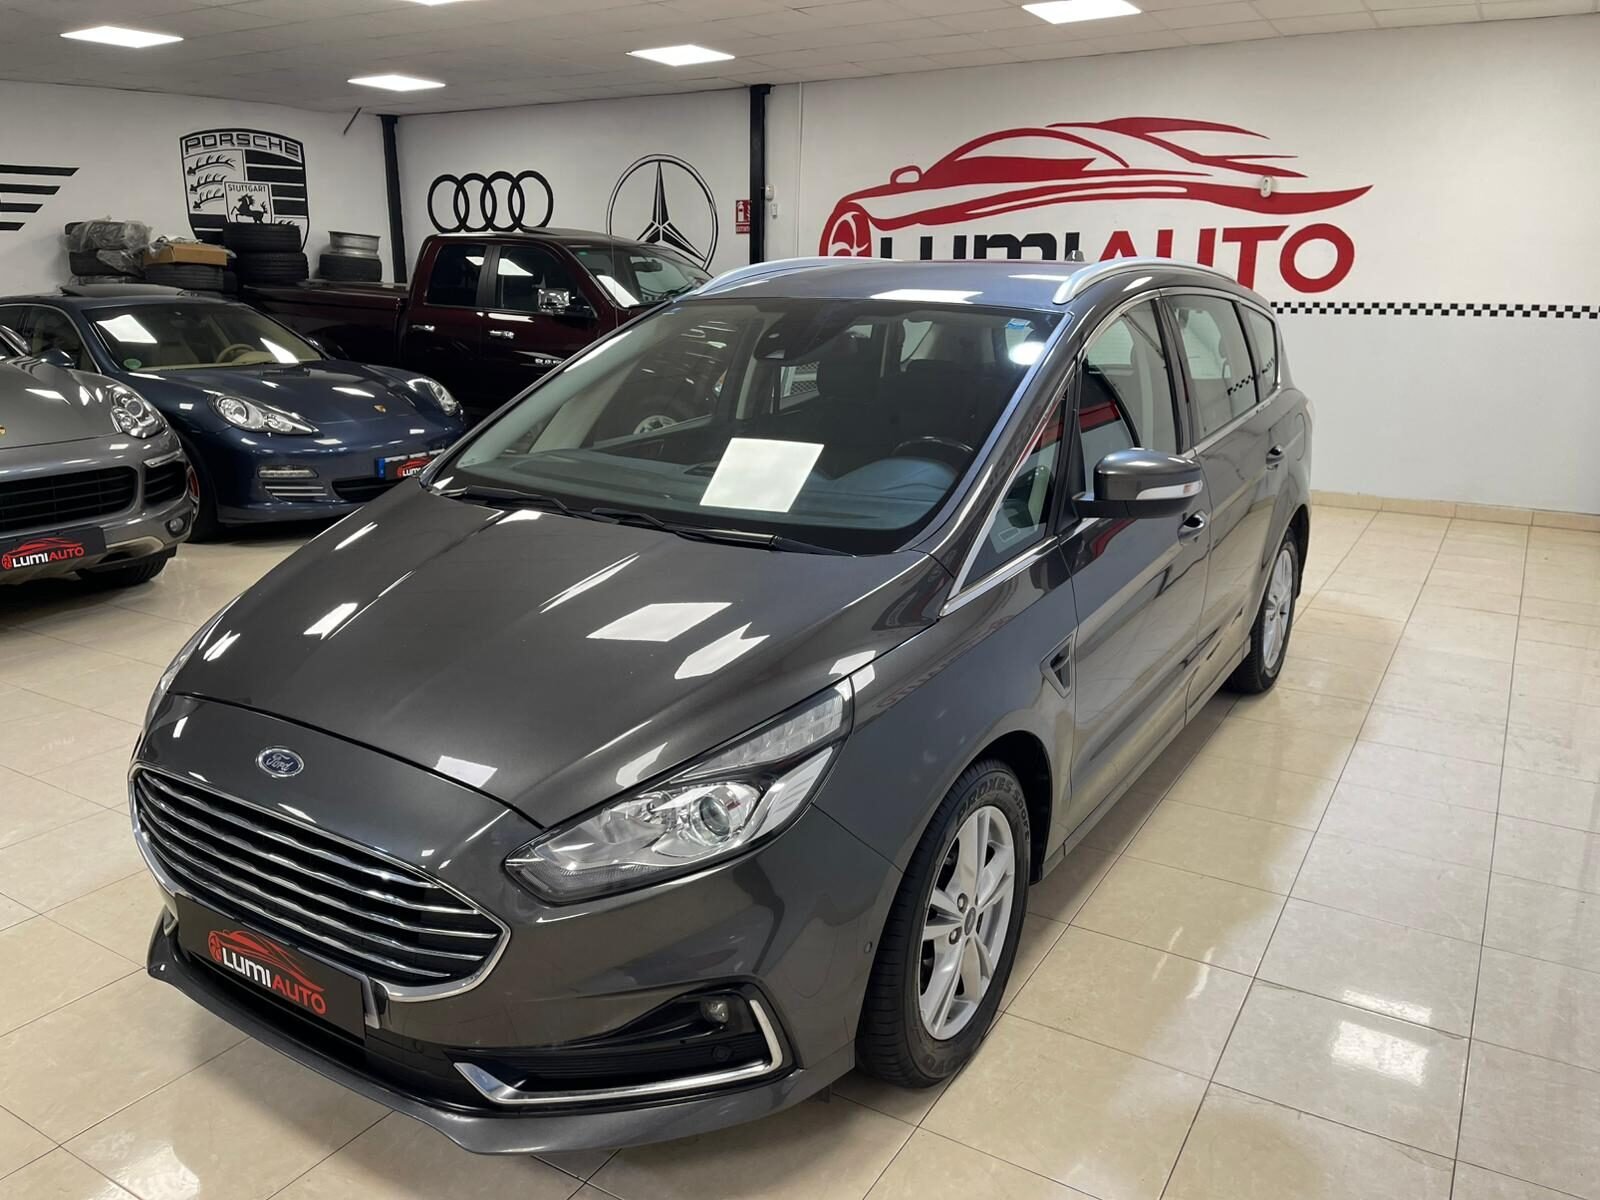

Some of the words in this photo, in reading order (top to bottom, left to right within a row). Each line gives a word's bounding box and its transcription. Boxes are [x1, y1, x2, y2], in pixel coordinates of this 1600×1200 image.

[184, 133, 299, 157] PORSCHE
[228, 184, 267, 193] STUTTGART
[12, 546, 85, 568] LUMIAUTO
[265, 752, 294, 772] Ford
[222, 946, 327, 1015] LUMIAUTO
